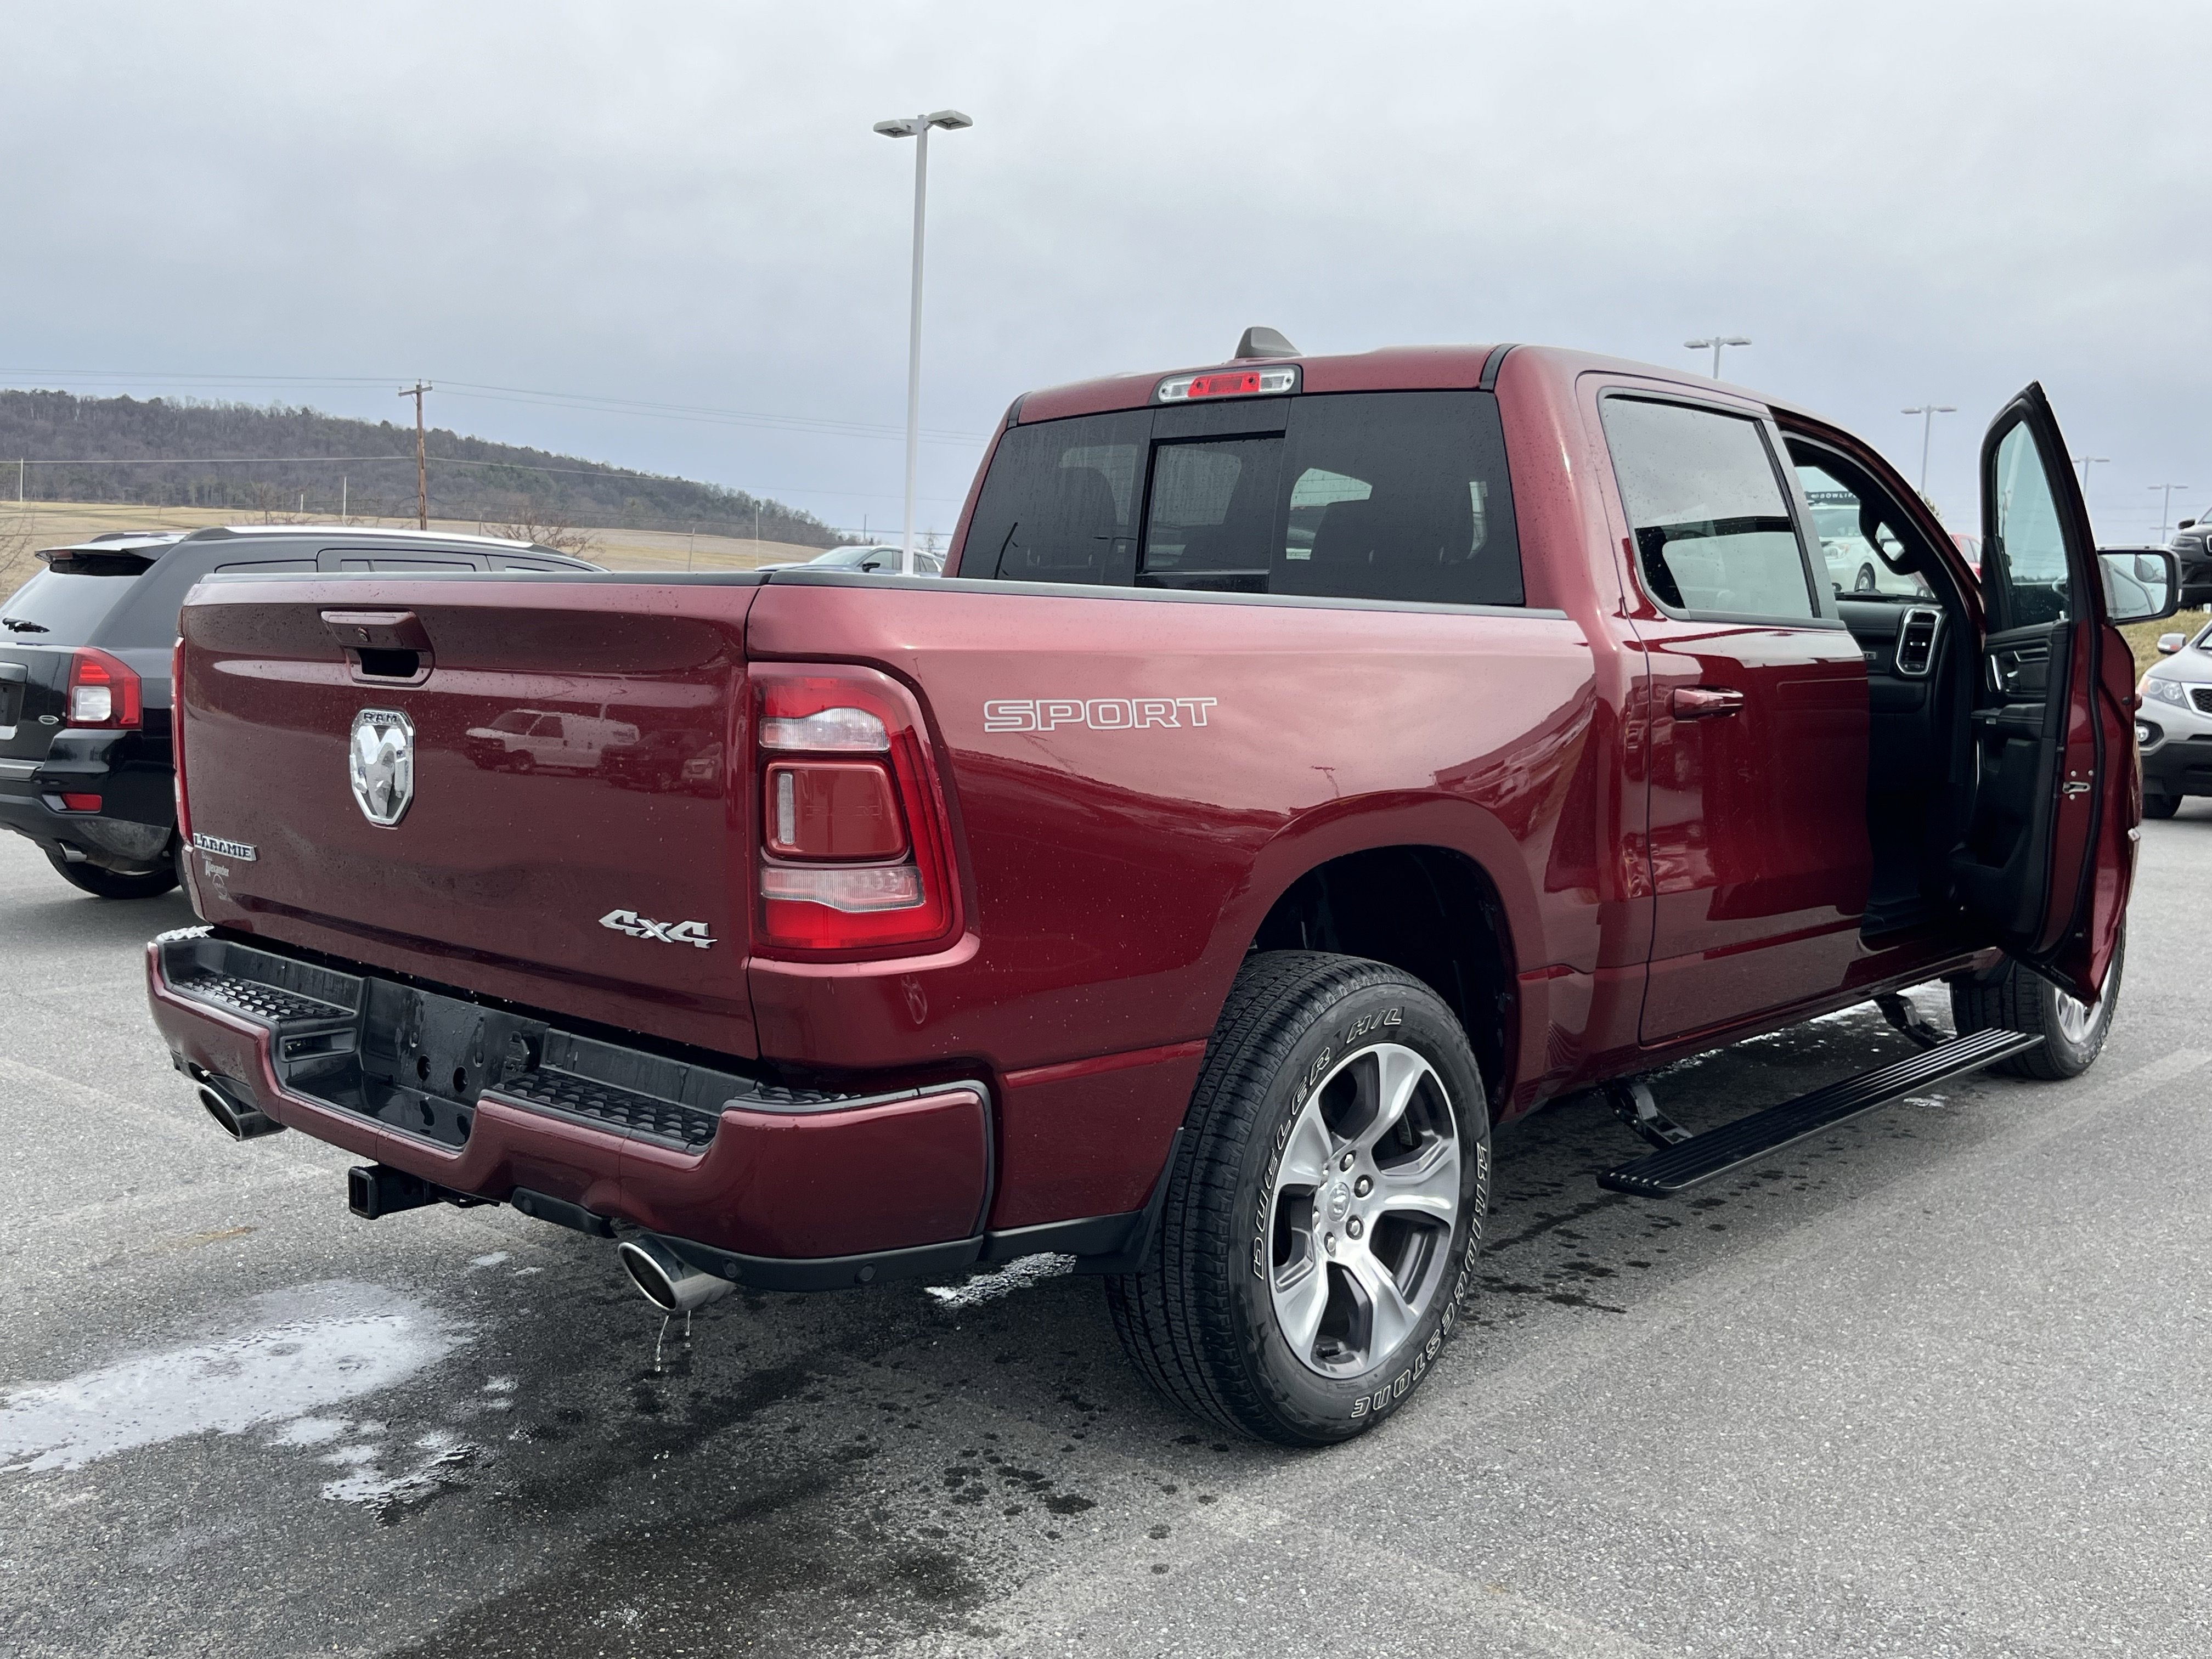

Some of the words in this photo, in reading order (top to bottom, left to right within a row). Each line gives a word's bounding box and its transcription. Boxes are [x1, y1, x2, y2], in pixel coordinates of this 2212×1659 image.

[364, 713, 397, 723] RAM
[984, 697, 1218, 733] SPORT
[194, 834, 251, 858] LARAMIE
[1253, 1046, 1331, 1280] DUELER
[1346, 1008, 1402, 1044] H/L
[1350, 1141, 1488, 1419] BRIDGESTONE
